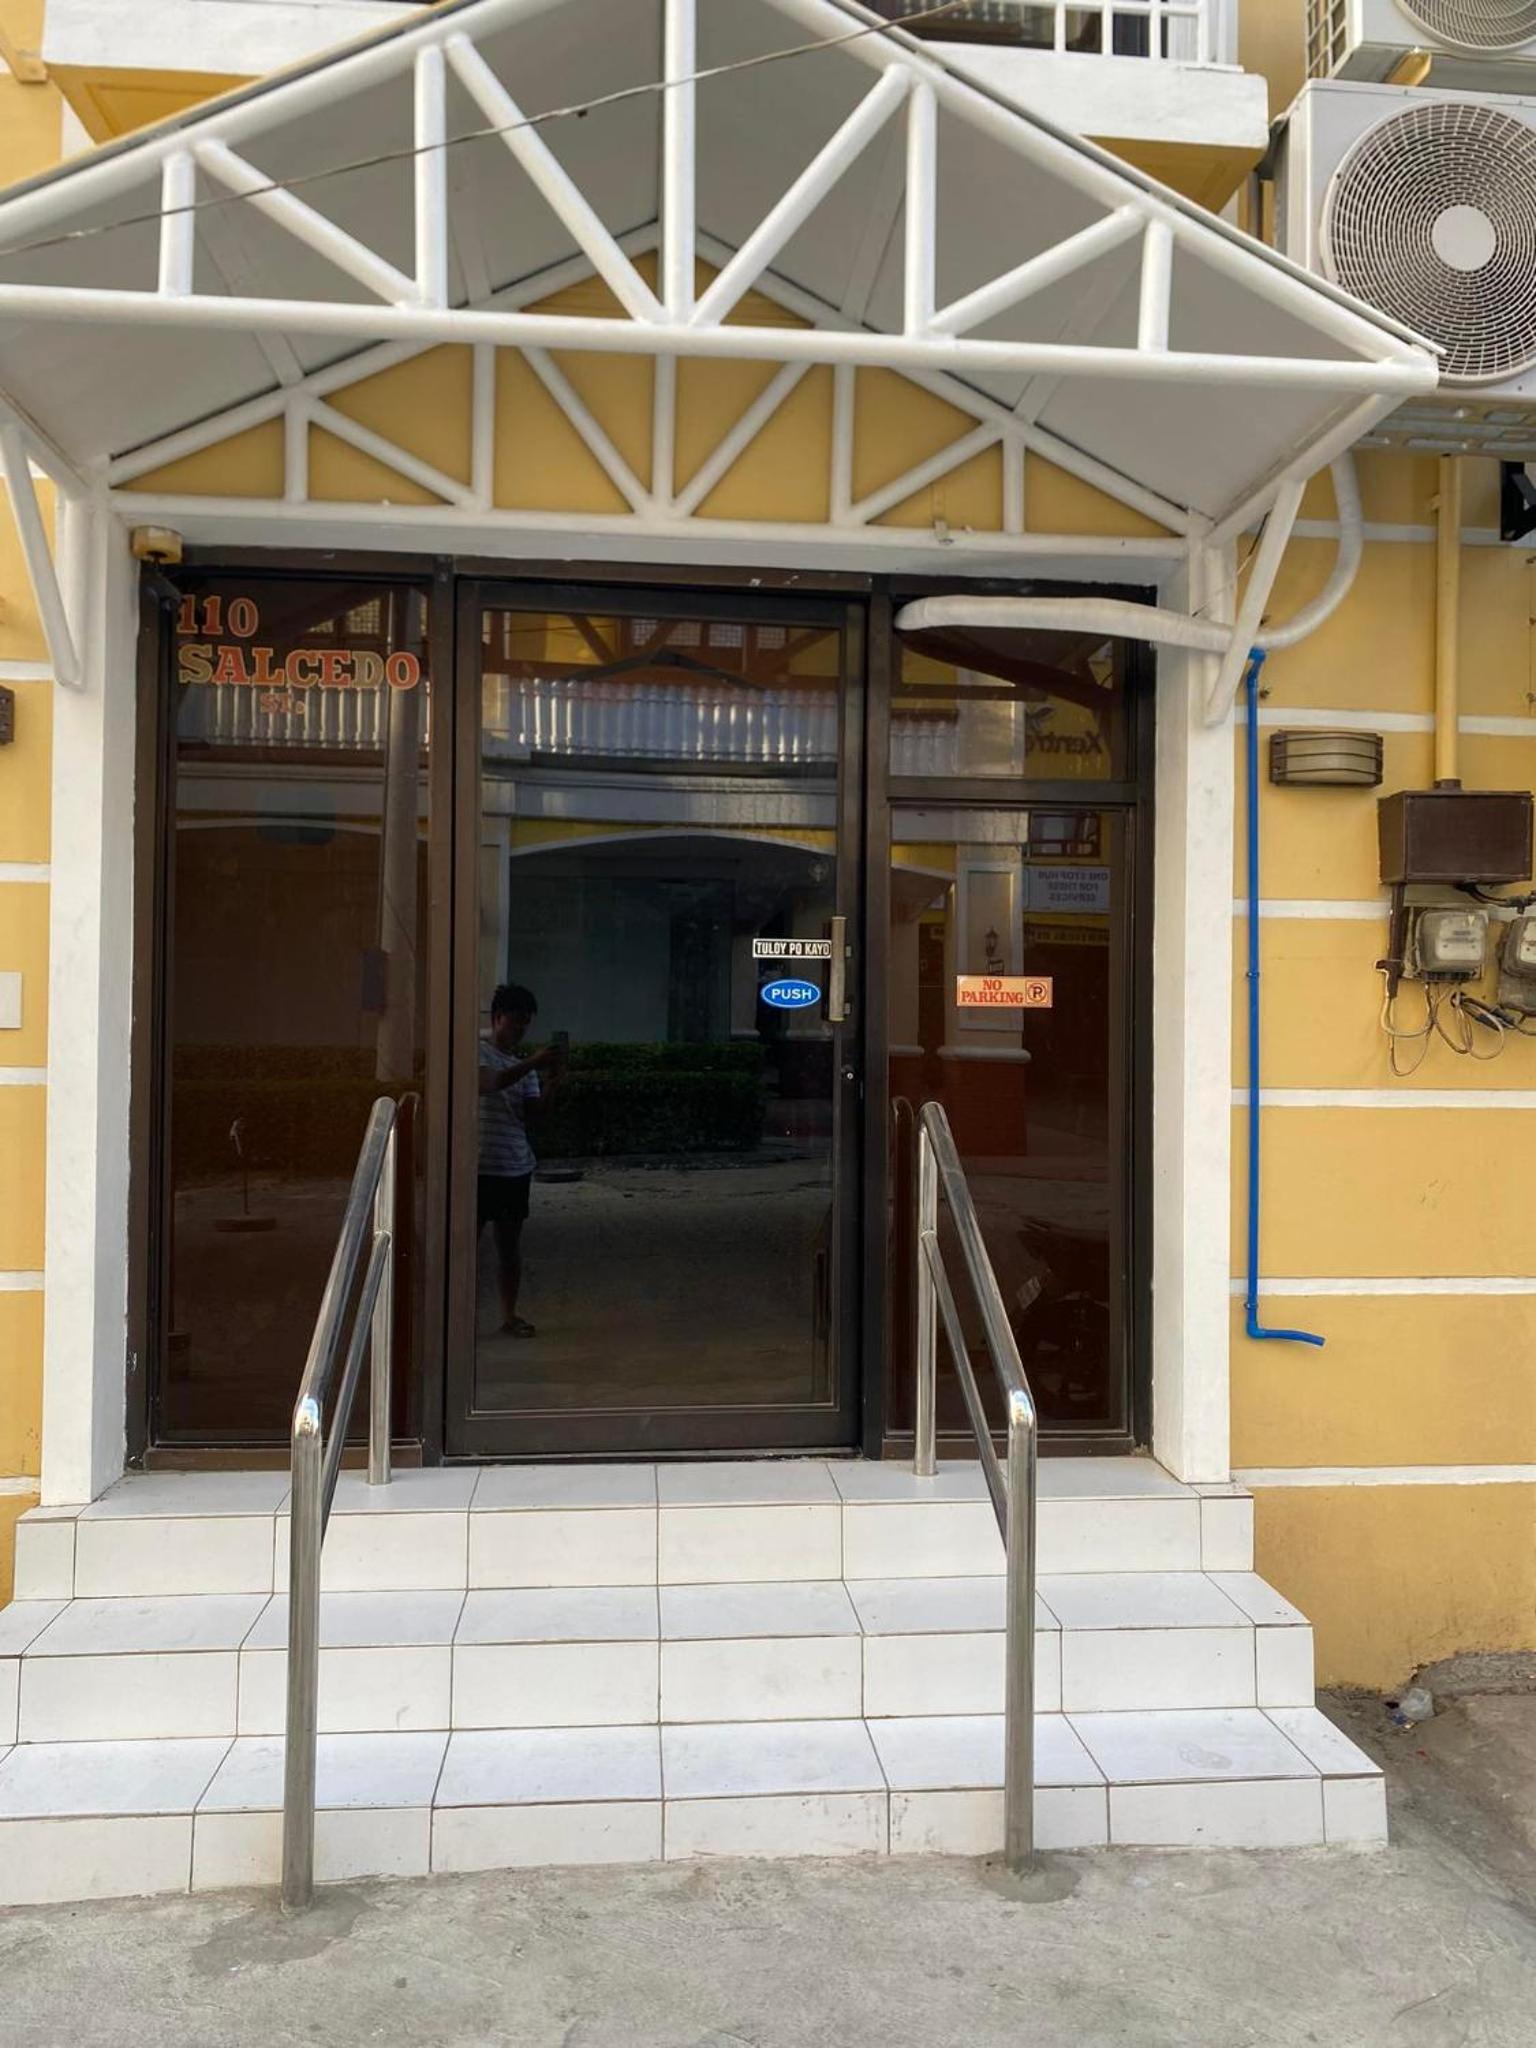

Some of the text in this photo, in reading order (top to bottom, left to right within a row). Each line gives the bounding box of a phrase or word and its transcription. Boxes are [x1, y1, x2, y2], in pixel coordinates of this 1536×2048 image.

[176, 594, 259, 638] 110
[178, 643, 420, 690] SALCEDO
[756, 941, 830, 956] TULOY PO KAYO
[982, 979, 1003, 991] NO
[771, 987, 812, 1000] PUSH
[961, 991, 1024, 1004] PARKING
